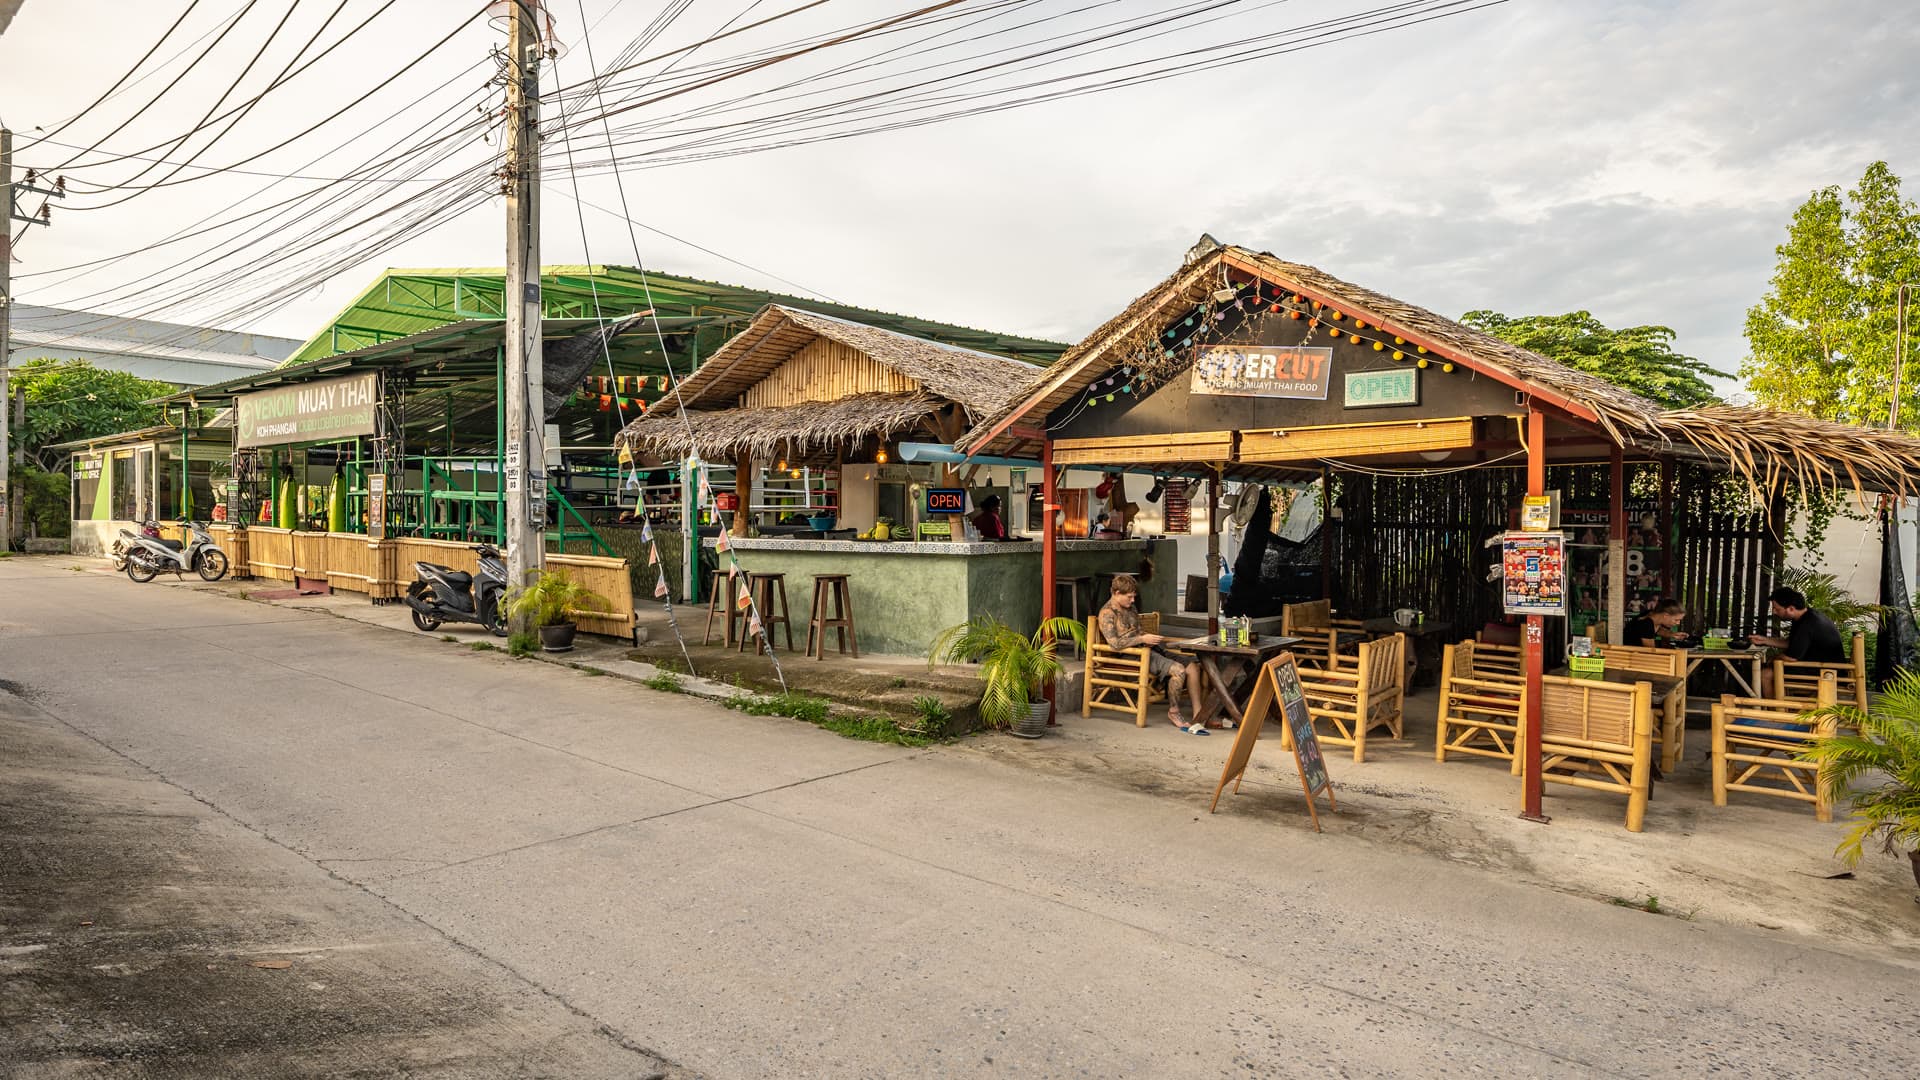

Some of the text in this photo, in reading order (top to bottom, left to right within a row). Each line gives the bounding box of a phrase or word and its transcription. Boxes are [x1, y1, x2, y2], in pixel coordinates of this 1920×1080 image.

[1274, 382, 1292, 391] THAI
[1294, 383, 1318, 392] FOOD
[1350, 376, 1411, 400] OPEN
[255, 377, 372, 420] VENOM MUAY THAI
[256, 421, 297, 438] KOH PHANGAN
[930, 494, 961, 508] OPEN
[1526, 558, 1539, 572] 5
